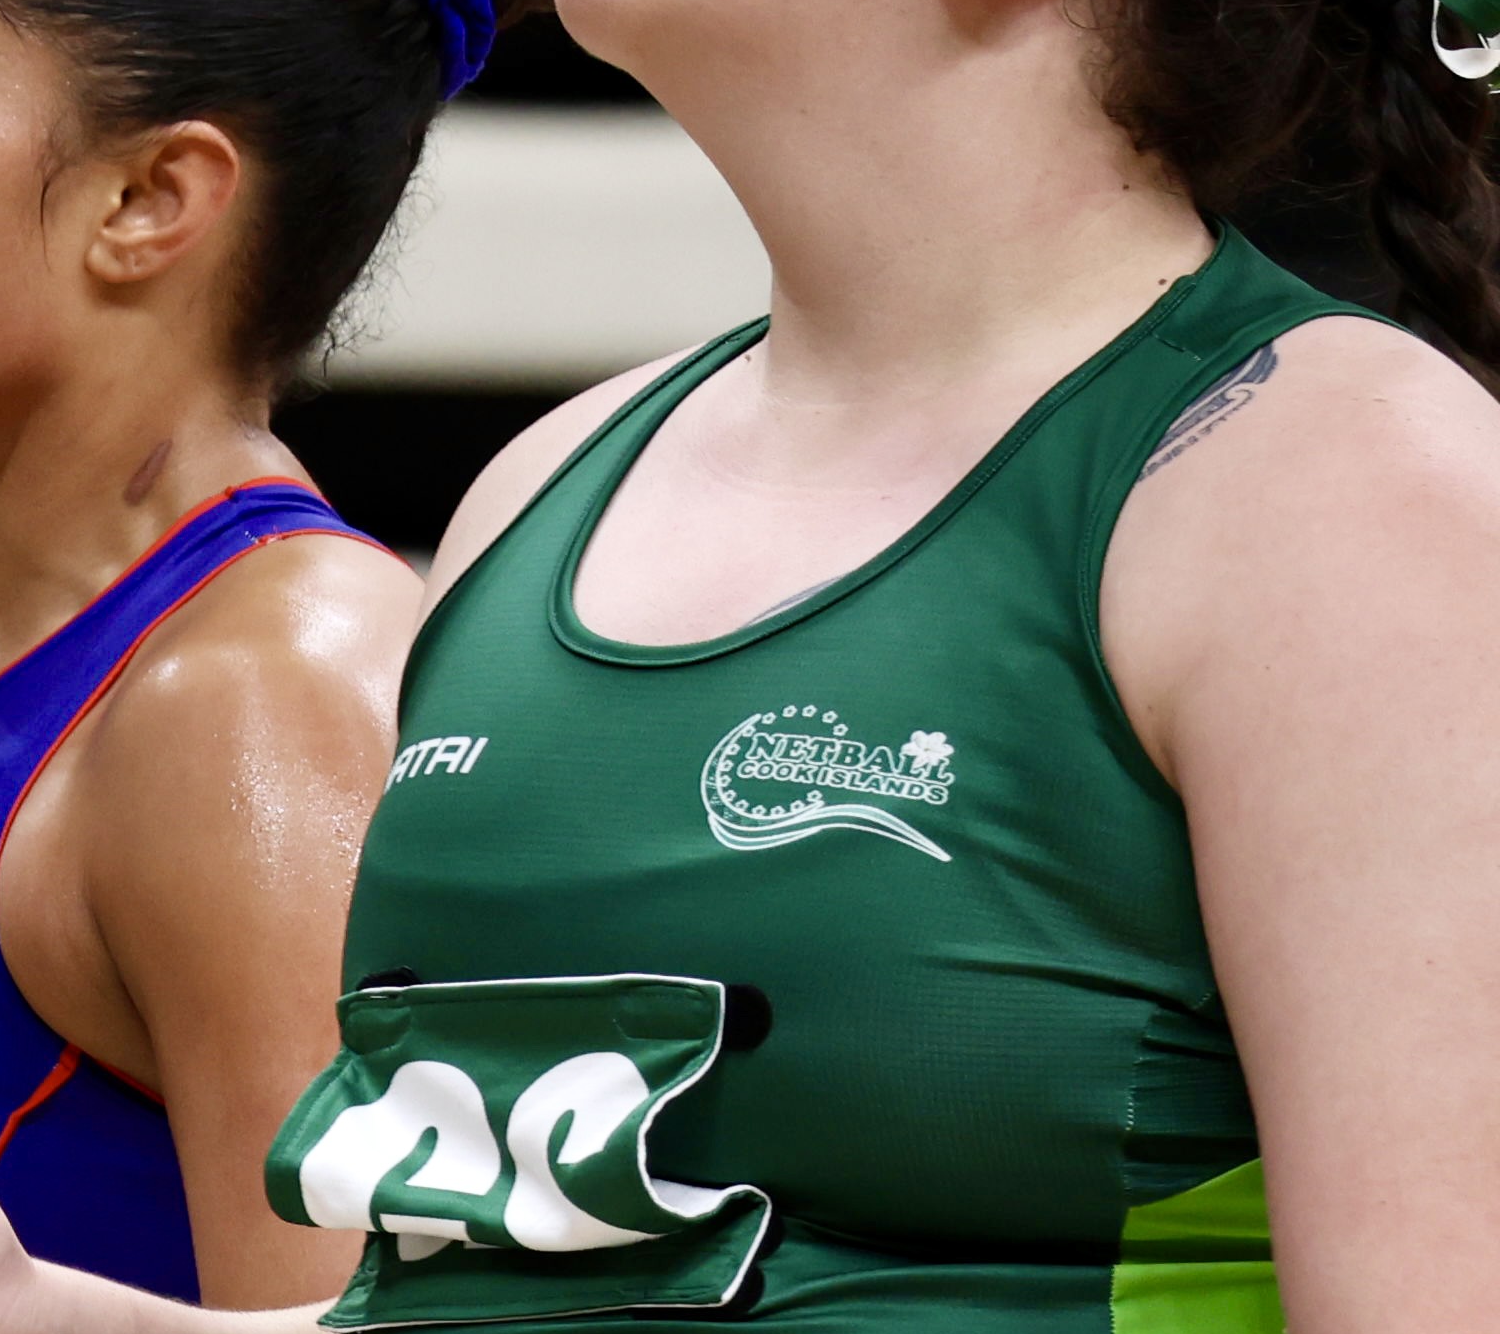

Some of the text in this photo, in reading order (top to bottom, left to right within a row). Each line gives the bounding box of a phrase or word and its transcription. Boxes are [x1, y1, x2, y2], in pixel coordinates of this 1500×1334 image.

[383, 736, 489, 795] ATAI
[736, 760, 949, 805] COOK ISLANDS
